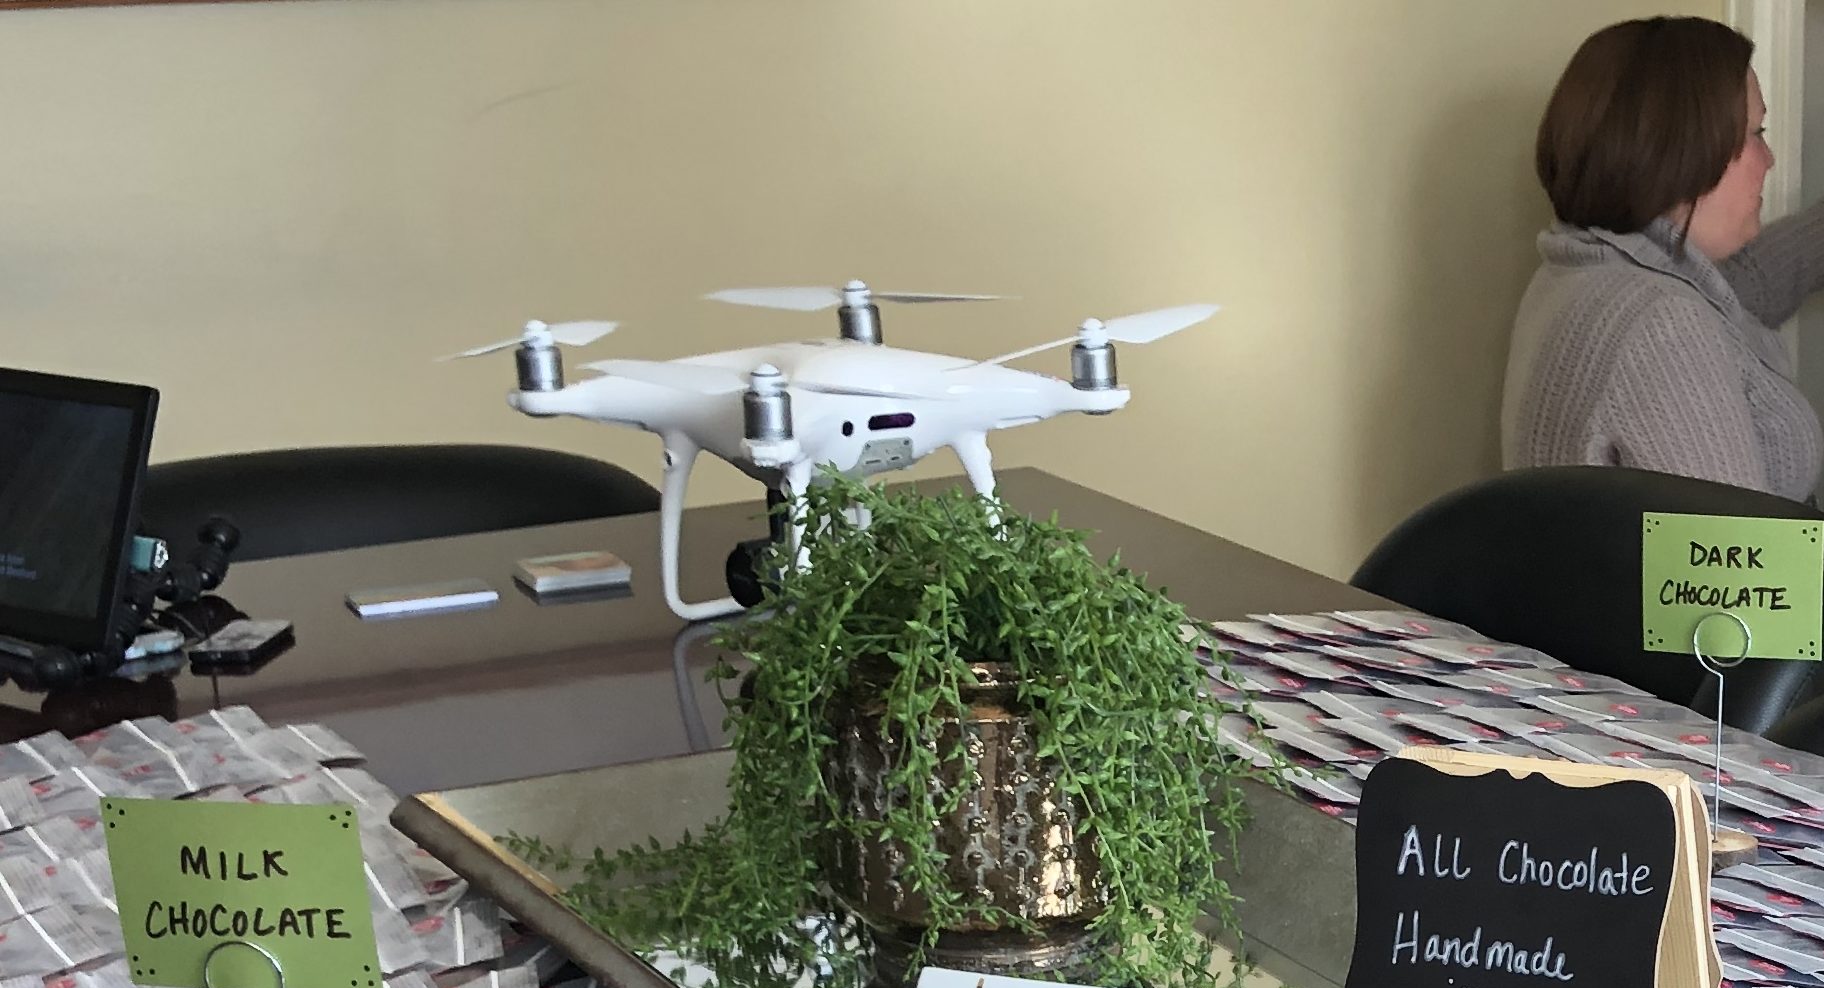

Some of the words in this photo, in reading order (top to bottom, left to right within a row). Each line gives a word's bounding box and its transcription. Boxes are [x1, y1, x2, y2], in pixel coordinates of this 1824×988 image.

[1689, 541, 1764, 569] DARK
[1659, 579, 1792, 611] CHOCOLATE
[180, 845, 289, 881] MILK
[1396, 824, 1471, 881] All
[1498, 839, 1654, 897] Chocolate
[145, 900, 352, 940] CHOCOLATE
[1391, 910, 1574, 982] Handmade
